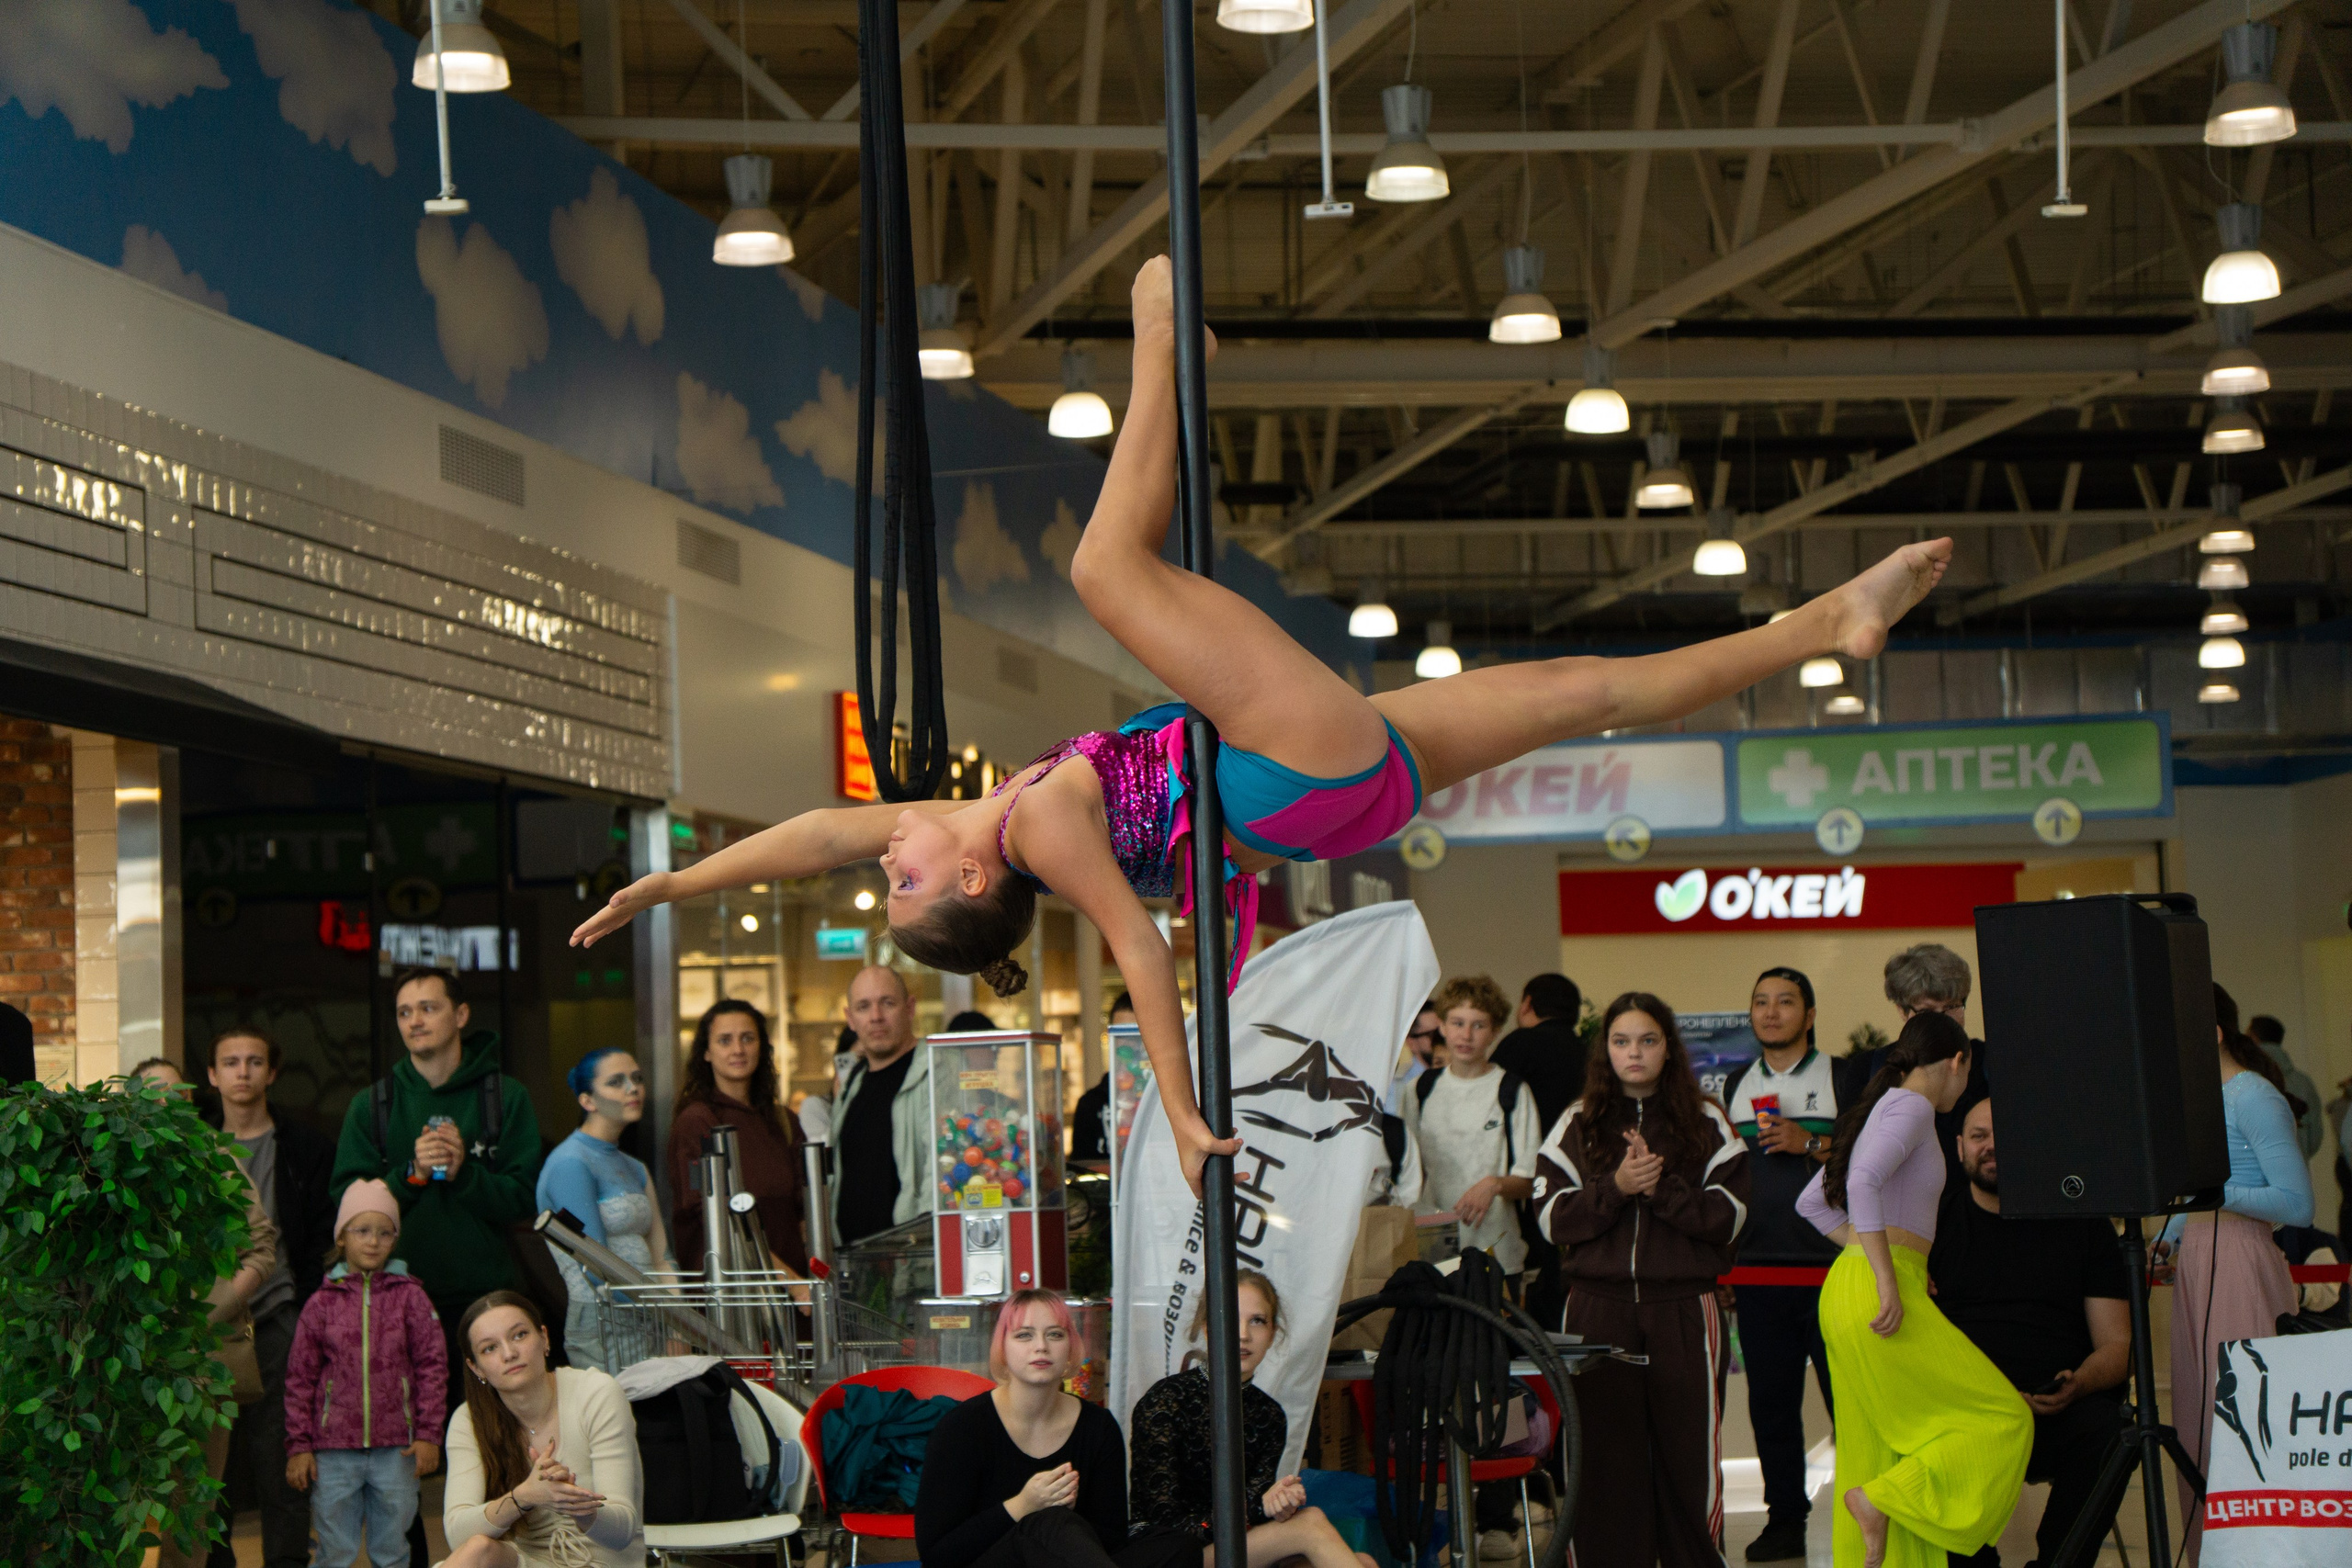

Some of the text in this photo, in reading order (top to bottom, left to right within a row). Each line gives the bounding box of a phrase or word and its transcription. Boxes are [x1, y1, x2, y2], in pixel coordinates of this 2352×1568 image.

[1851, 741, 2105, 795] АПТЕКА
[2290, 1449, 2329, 1470] pole
[2207, 1498, 2295, 1522] ЦЕНТР
